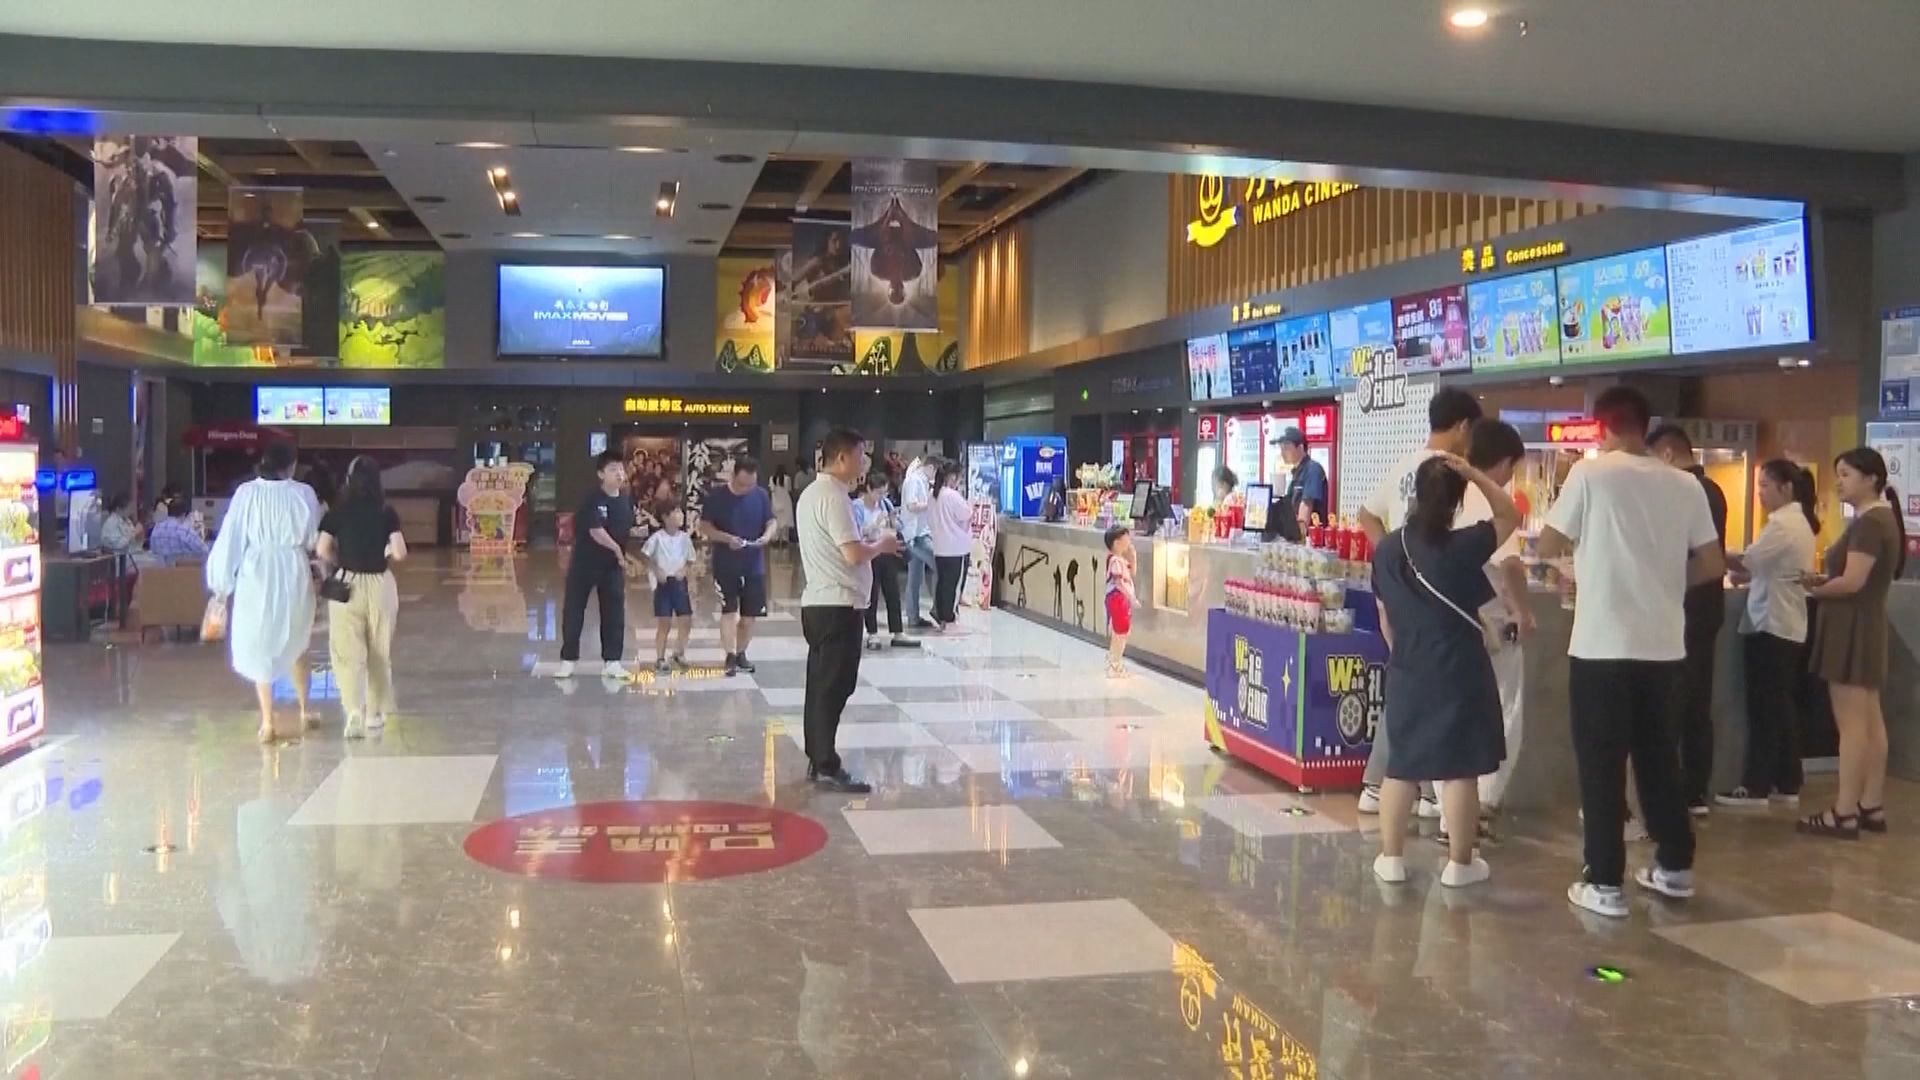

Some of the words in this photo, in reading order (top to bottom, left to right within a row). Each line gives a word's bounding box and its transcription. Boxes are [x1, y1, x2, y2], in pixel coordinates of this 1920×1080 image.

[1253, 190, 1300, 225] WANDA
[1304, 181, 1359, 206] CINE
[1506, 242, 1564, 264] Concession
[684, 404, 706, 413] AUTO
[707, 404, 732, 414] TICKET
[733, 405, 750, 414] BOX
